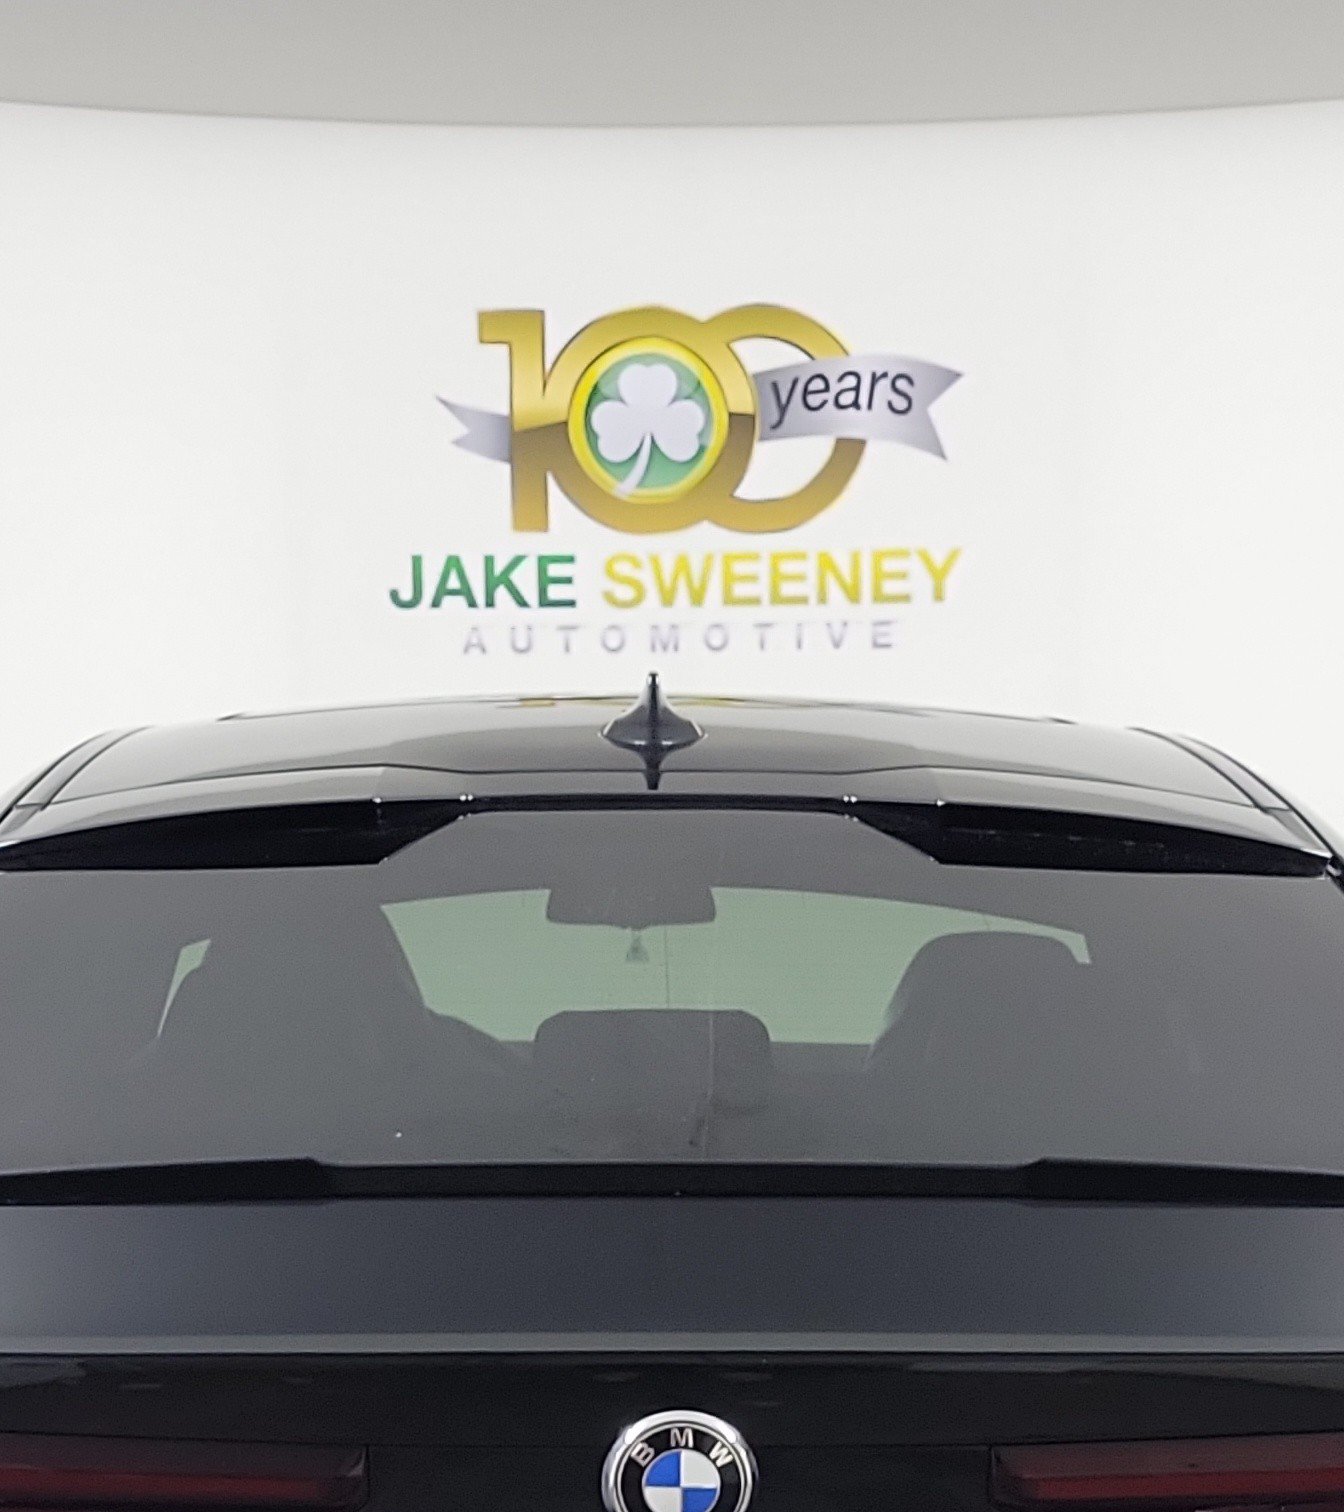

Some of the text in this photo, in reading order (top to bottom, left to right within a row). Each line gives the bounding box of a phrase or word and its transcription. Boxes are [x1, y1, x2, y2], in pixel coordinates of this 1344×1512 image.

[477, 302, 915, 535] 100 years
[388, 547, 963, 609] JAKE SWEENEY
[462, 620, 897, 655] AUTOMOTIVE
[630, 1427, 734, 1468] BMW
